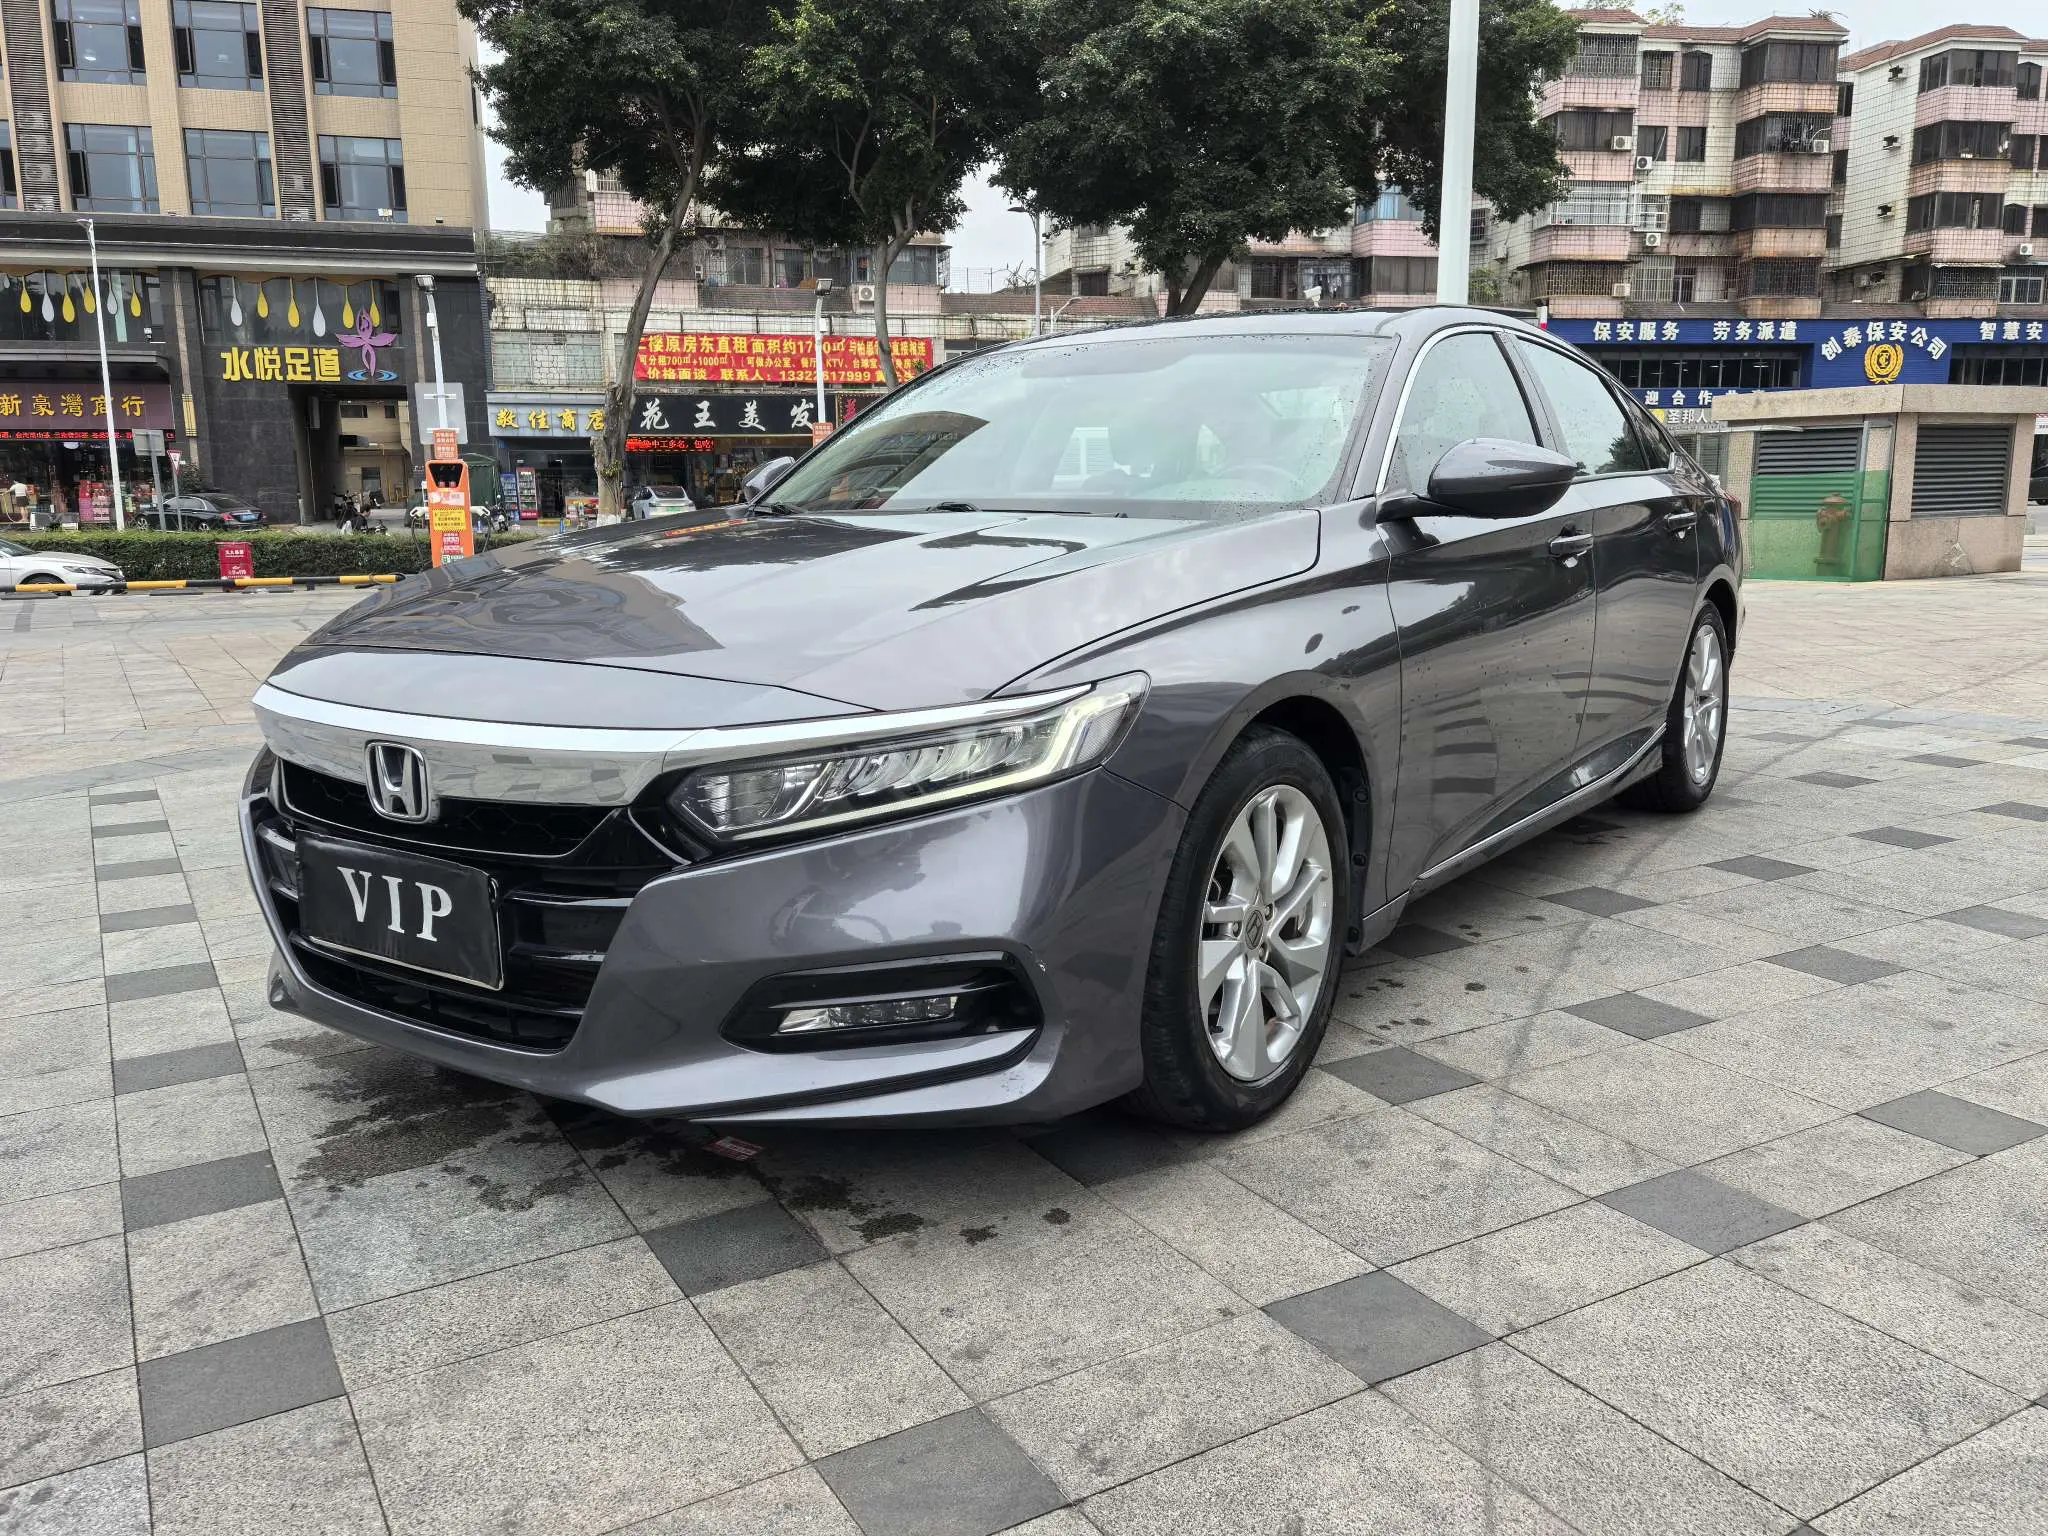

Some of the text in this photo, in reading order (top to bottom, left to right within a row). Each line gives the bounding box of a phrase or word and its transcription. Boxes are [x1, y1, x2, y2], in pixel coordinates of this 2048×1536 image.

[1593, 322, 1798, 341] 保安服务 劳务派遣
[1821, 321, 1948, 361] 创泰保安公司
[1979, 321, 2043, 341] 智慧安
[220, 346, 341, 382] 水悦足道
[647, 367, 707, 380] 价格面谈
[640, 398, 815, 432] 花王美发
[1667, 409, 1720, 424] 圣邦人
[337, 866, 453, 942] VIP
